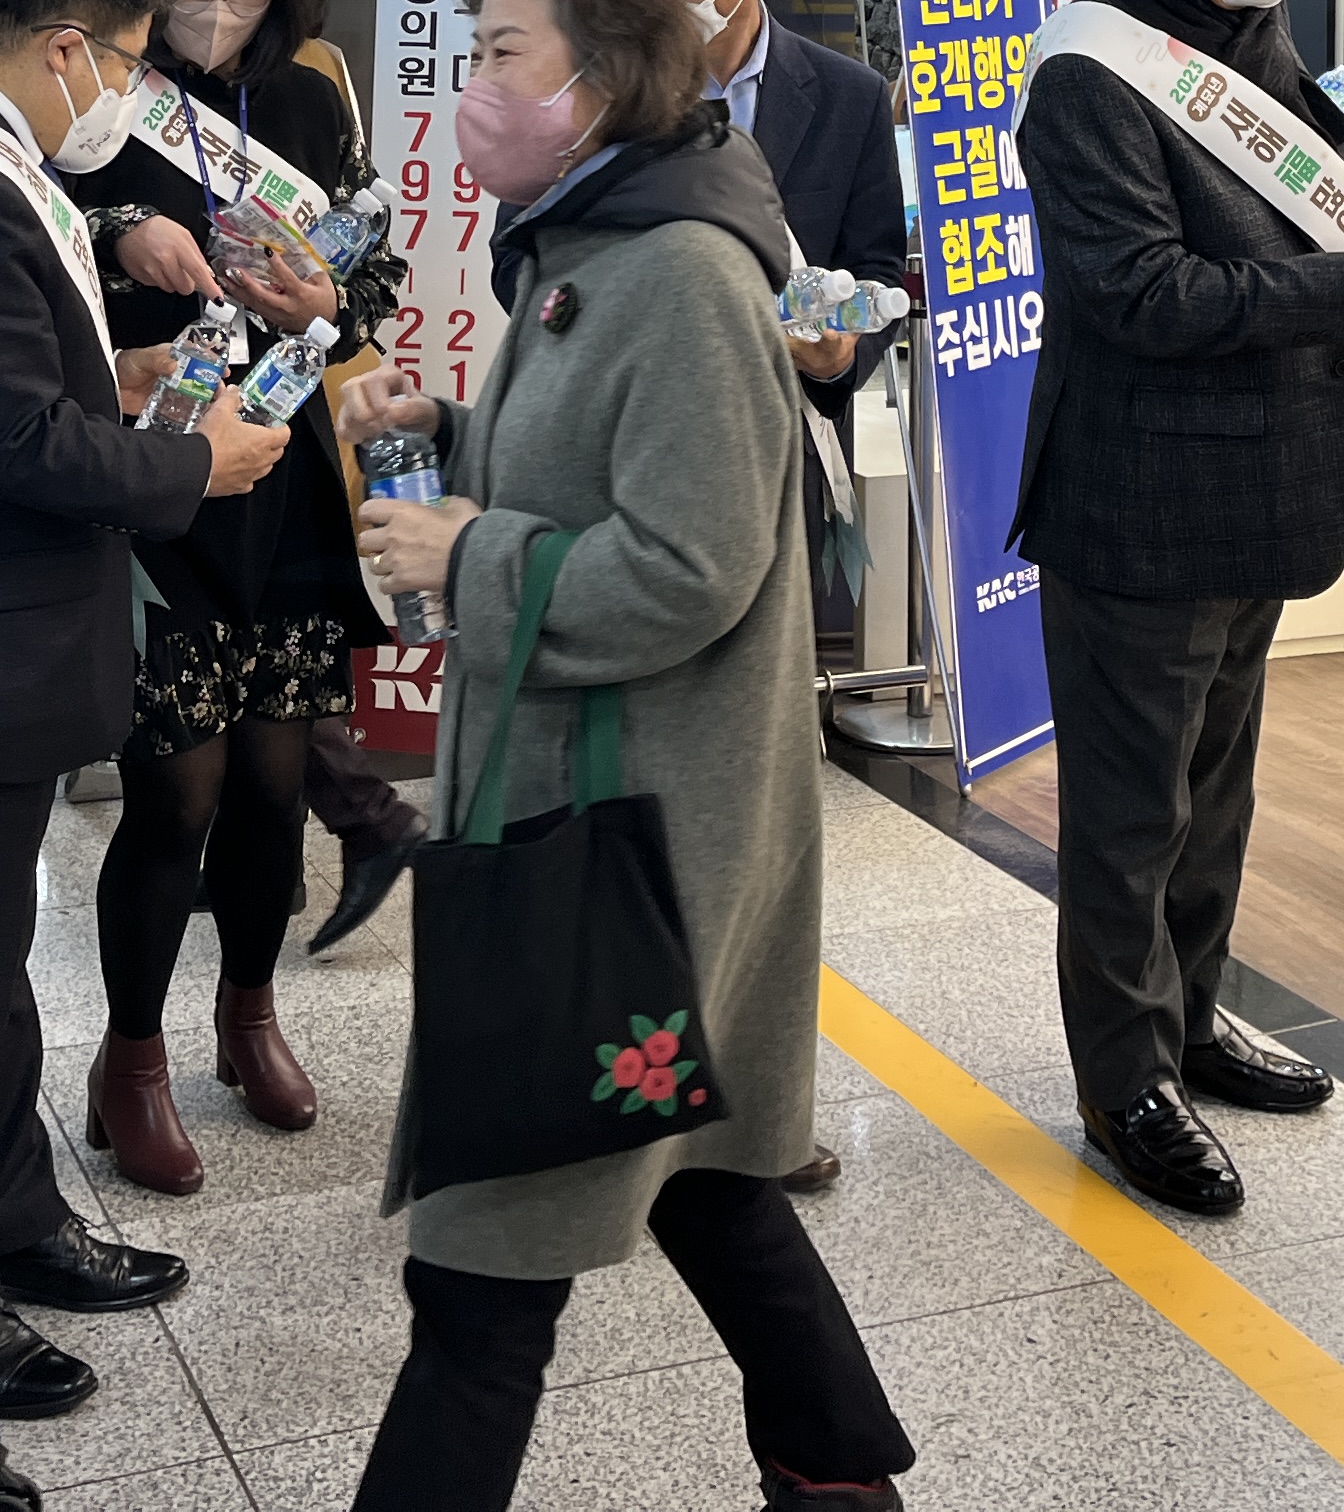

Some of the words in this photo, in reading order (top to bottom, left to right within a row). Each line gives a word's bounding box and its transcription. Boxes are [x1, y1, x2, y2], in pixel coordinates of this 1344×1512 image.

[1169, 59, 1204, 105] 2023
[1191, 76, 1224, 118] 계묘년
[142, 90, 177, 131] 2023
[199, 126, 263, 185] 새해
[1219, 96, 1289, 163] 새해
[1273, 143, 1322, 196] 福
[939, 212, 1035, 296] 협조해
[935, 290, 1045, 378] 주십시오
[976, 571, 1017, 613] KAC
